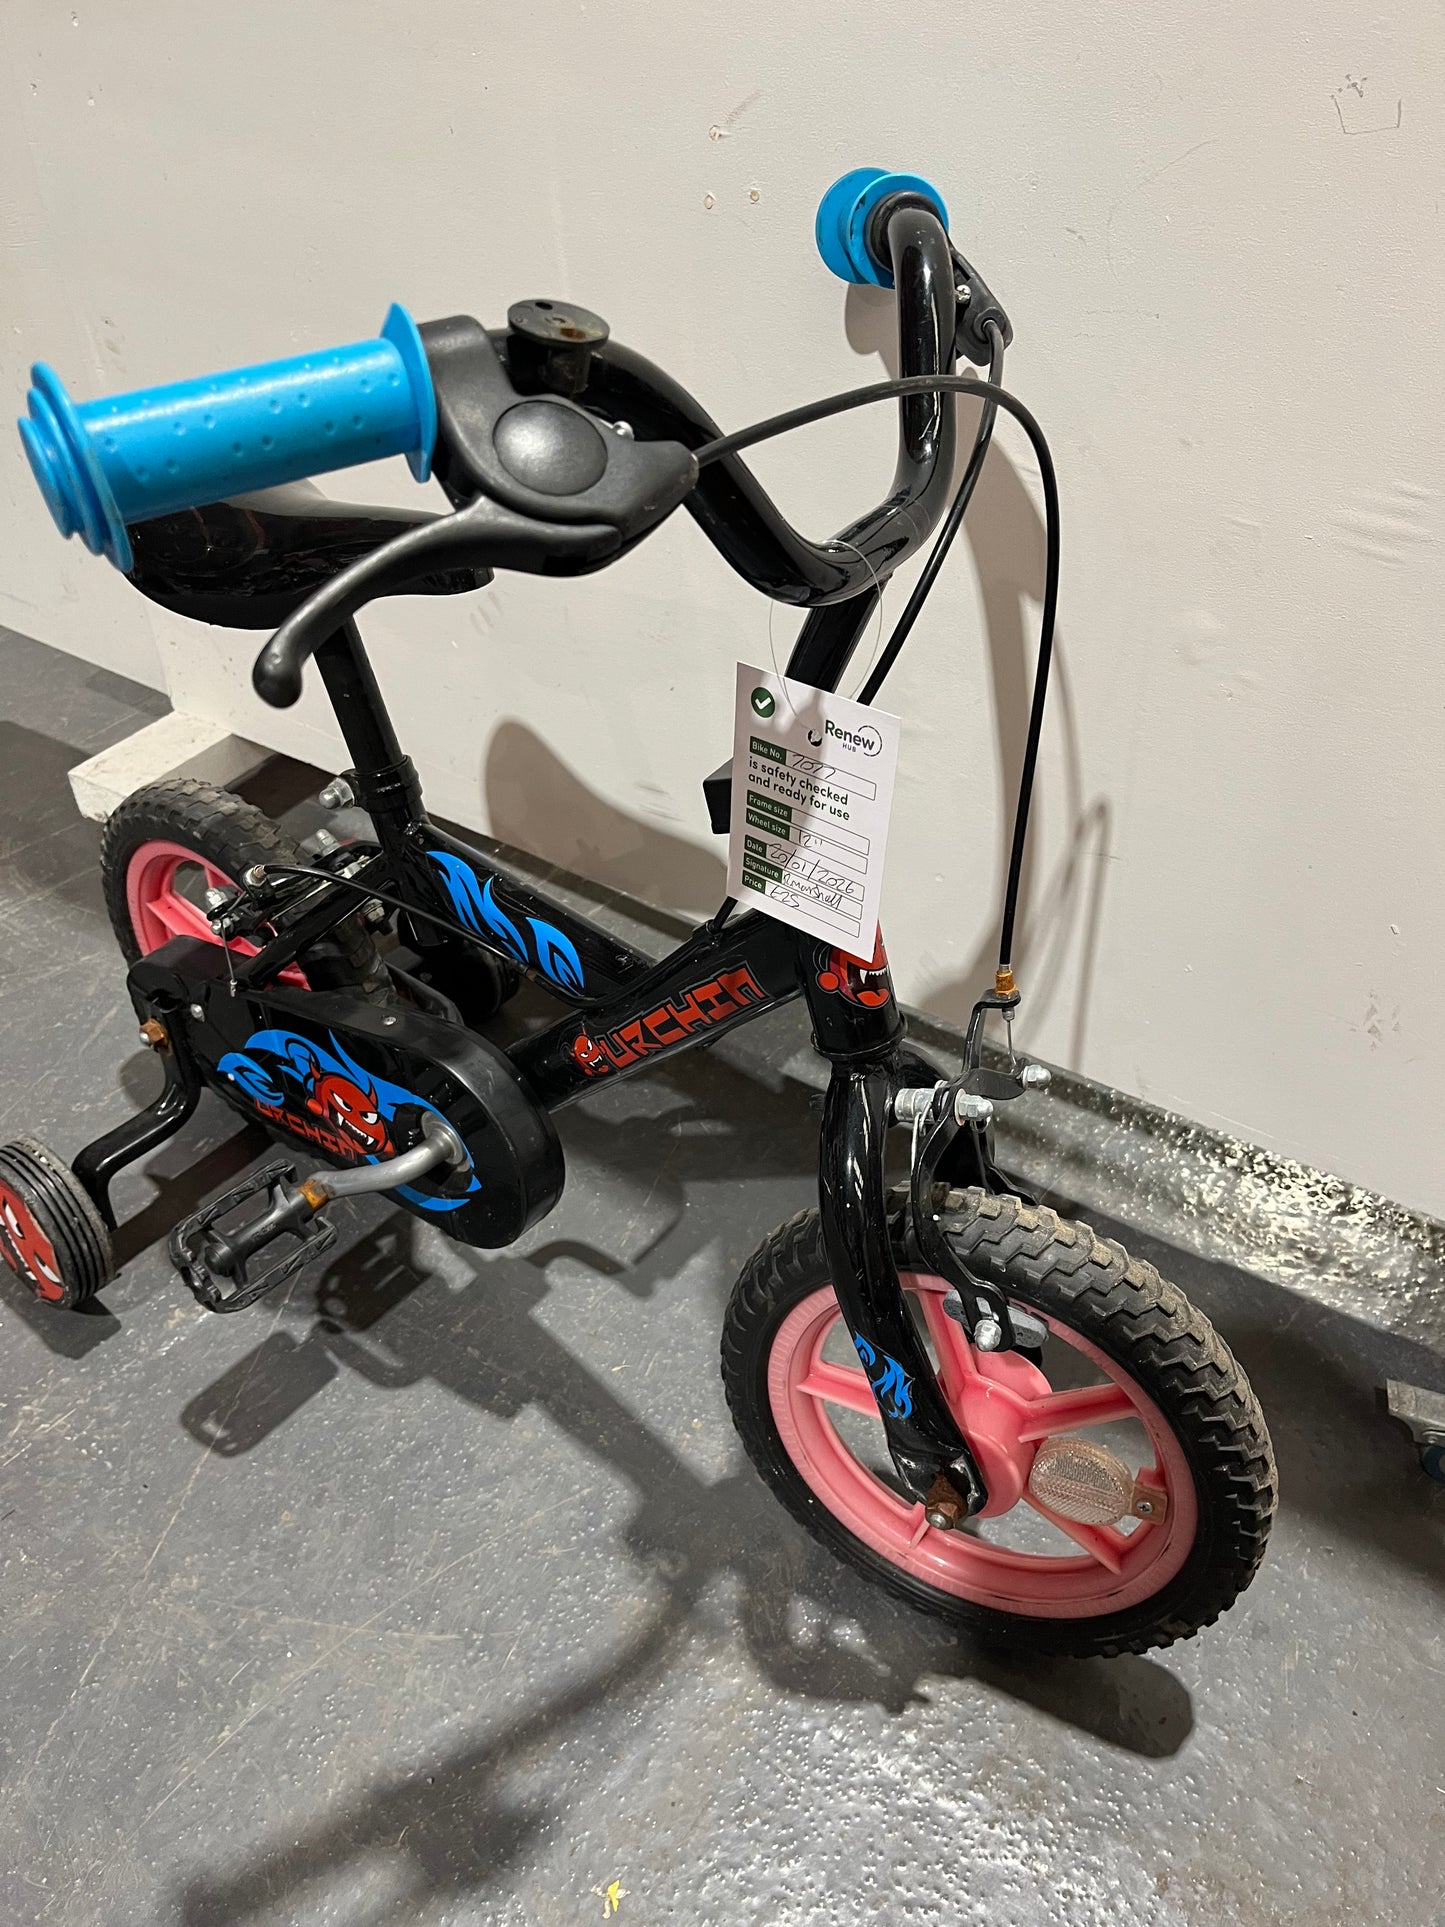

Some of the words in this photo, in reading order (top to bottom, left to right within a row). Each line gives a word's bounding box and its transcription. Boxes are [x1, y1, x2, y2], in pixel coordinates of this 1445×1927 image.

[825, 719, 875, 751] Renew
[752, 741, 768, 755] Bike
[769, 750, 783, 760] No.
[842, 742, 857, 752] HUB
[749, 756, 758, 770] is
[761, 765, 797, 788] safety
[799, 780, 849, 805] checked
[748, 773, 770, 789] and
[773, 783, 807, 806] ready
[809, 795, 827, 811] for
[829, 807, 850, 821] use
[749, 795, 772, 809] Frame
[773, 804, 788, 817] size
[748, 813, 771, 829] Wheel
[772, 823, 786, 836] size
[746, 839, 763, 853] Date
[745, 857, 779, 878] Signature
[744, 875, 763, 889] Price
[600, 967, 765, 1069] URCHIN
